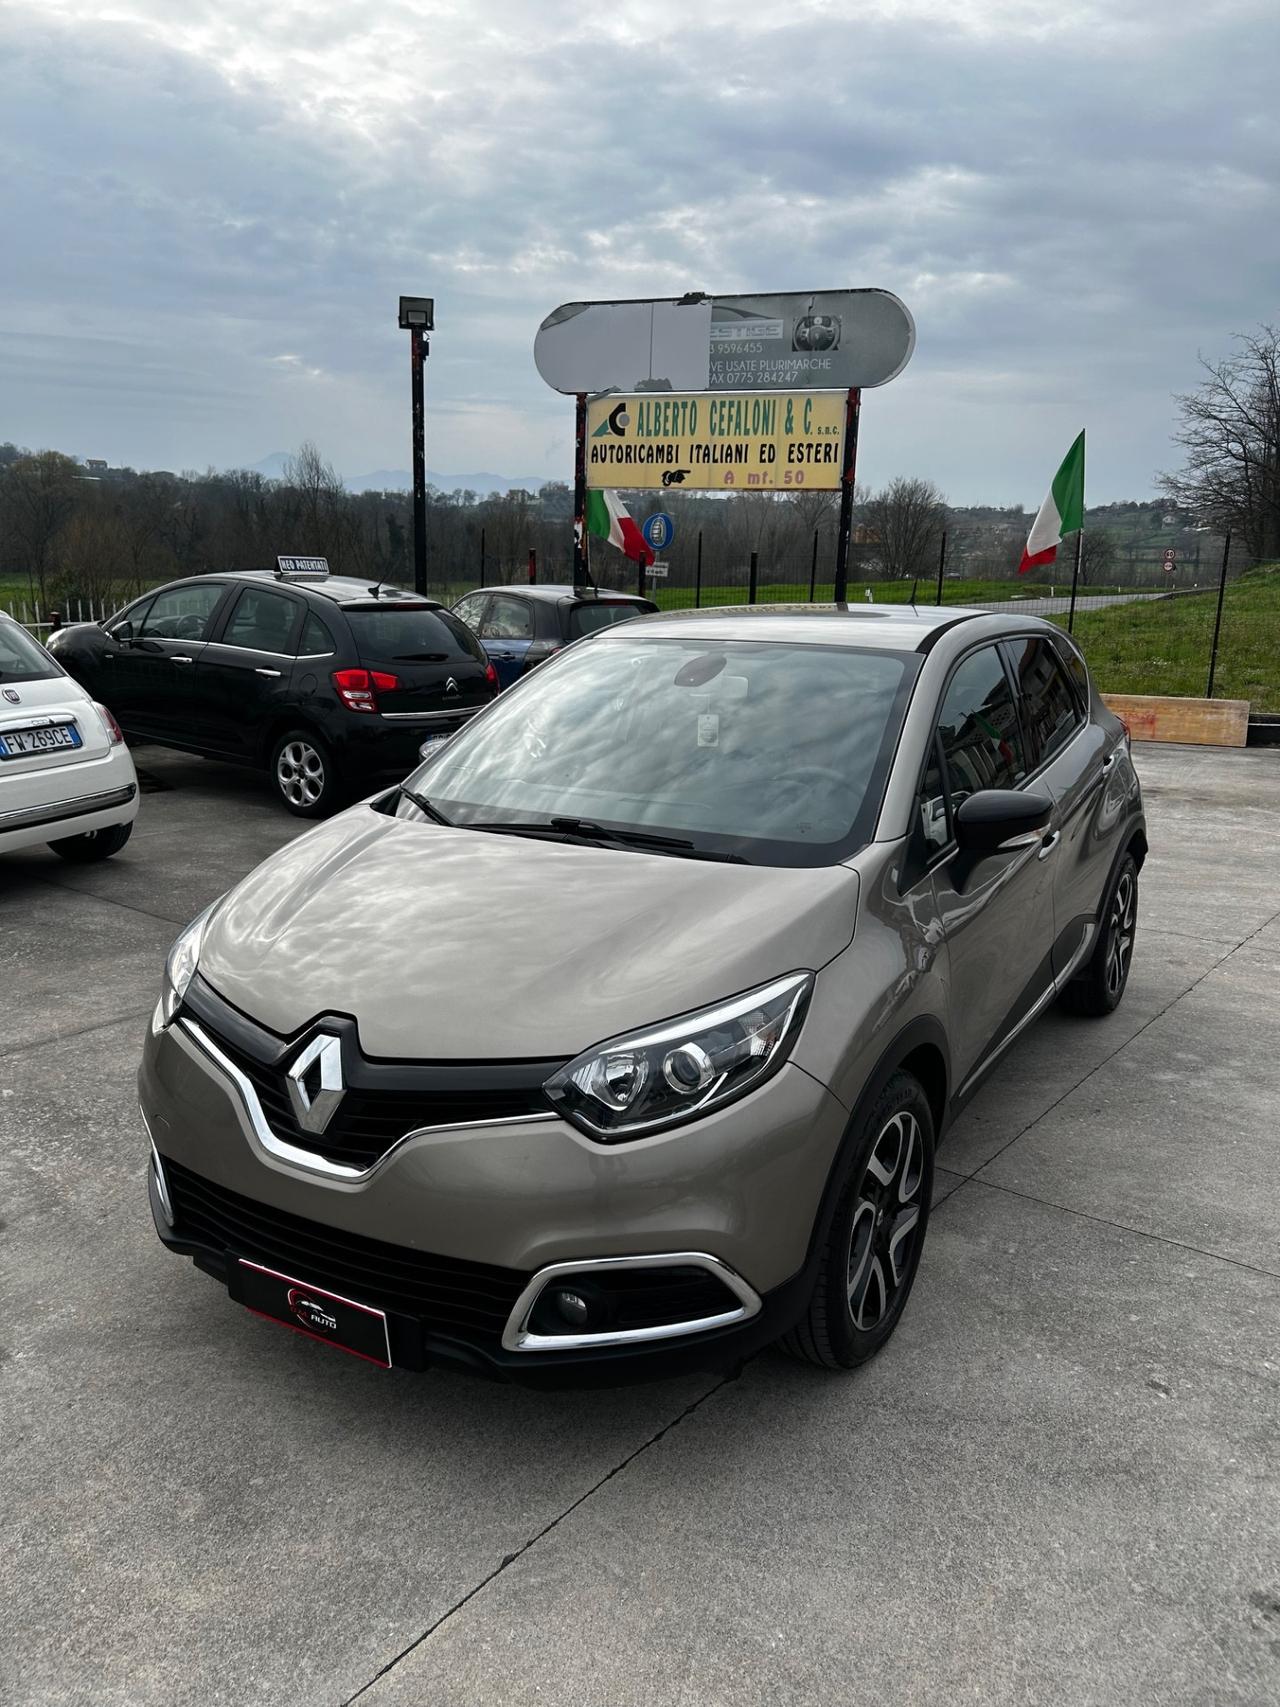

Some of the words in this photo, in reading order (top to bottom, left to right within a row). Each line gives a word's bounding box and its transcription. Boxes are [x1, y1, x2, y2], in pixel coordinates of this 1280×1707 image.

[717, 342, 763, 354] 9596455
[725, 360, 757, 372] USATE
[760, 358, 832, 371] PLURIMARCHE
[709, 372, 724, 384] AX
[726, 372, 754, 384] 0775
[757, 371, 799, 383] 284247
[637, 400, 697, 437] ALBERTO
[709, 398, 776, 437] CEFALONI
[784, 398, 794, 436] &
[804, 398, 813, 436] C.
[591, 444, 680, 464] AUTORICAMBI
[689, 443, 749, 464] ITALIANI
[759, 443, 776, 464] ED
[788, 442, 839, 464] ESTERI
[723, 470, 735, 485] A
[783, 470, 805, 485] 50
[4, 735, 26, 753] FW
[28, 728, 72, 748] 269CE
[310, 1314, 337, 1329] AUTO
